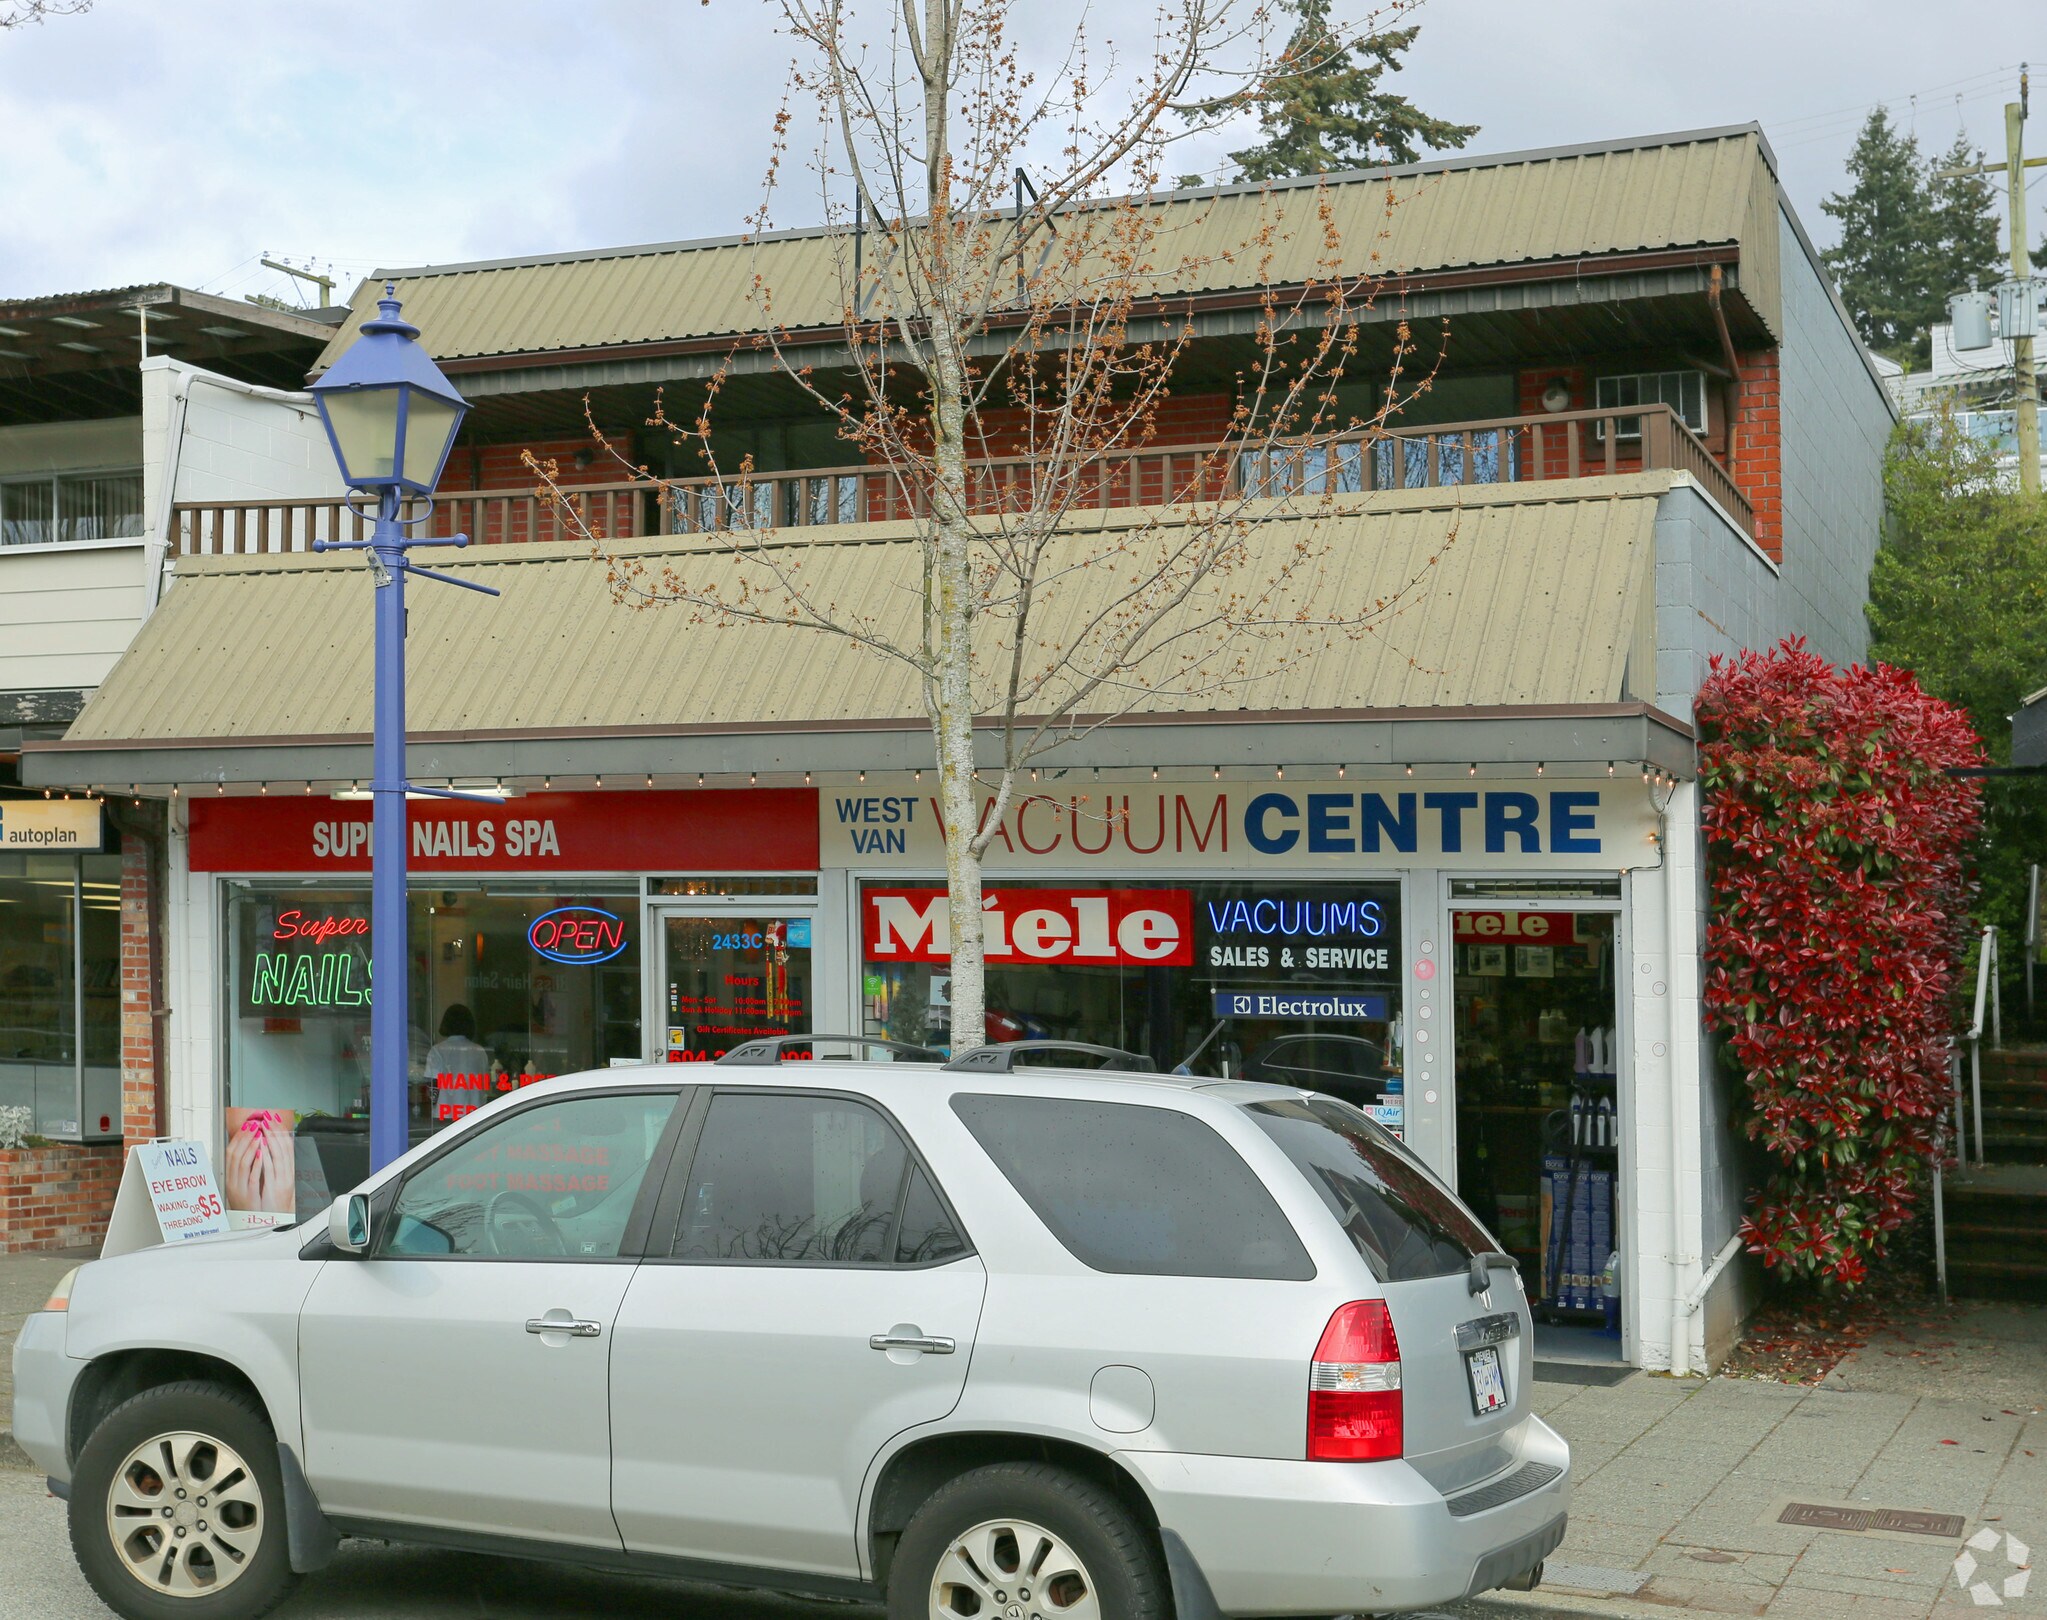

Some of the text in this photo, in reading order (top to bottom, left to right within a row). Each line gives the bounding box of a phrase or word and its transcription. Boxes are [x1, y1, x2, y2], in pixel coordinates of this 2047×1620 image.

[836, 797, 919, 823] WEST
[1244, 791, 1602, 854] CENTRE
[9, 827, 77, 845] autoplan
[313, 820, 561, 857] SUP NAILS SPA
[851, 829, 905, 853] VAN
[273, 910, 368, 945] Super
[872, 894, 1180, 959] Miele
[1208, 899, 1381, 937] VACUUMS
[1455, 911, 1549, 937] iele
[532, 920, 624, 949] OPEN
[712, 933, 763, 950] 2433C
[1210, 946, 1389, 970] SALES & SERVICE
[251, 954, 373, 1005] NAIL
[725, 975, 760, 986] Hours
[1258, 996, 1368, 1017] Electrolux
[713, 1026, 752, 1035] Certificates
[754, 1027, 789, 1037] Available
[437, 1073, 490, 1090] MANI
[496, 1073, 512, 1091] &
[1374, 1107, 1401, 1118] IQAir
[152, 1174, 207, 1194] EYE BROW
[506, 1172, 609, 1192] MASSAGE
[157, 1199, 189, 1213] WAXING
[198, 1193, 221, 1219] $5
[163, 1215, 203, 1231] THREADING
